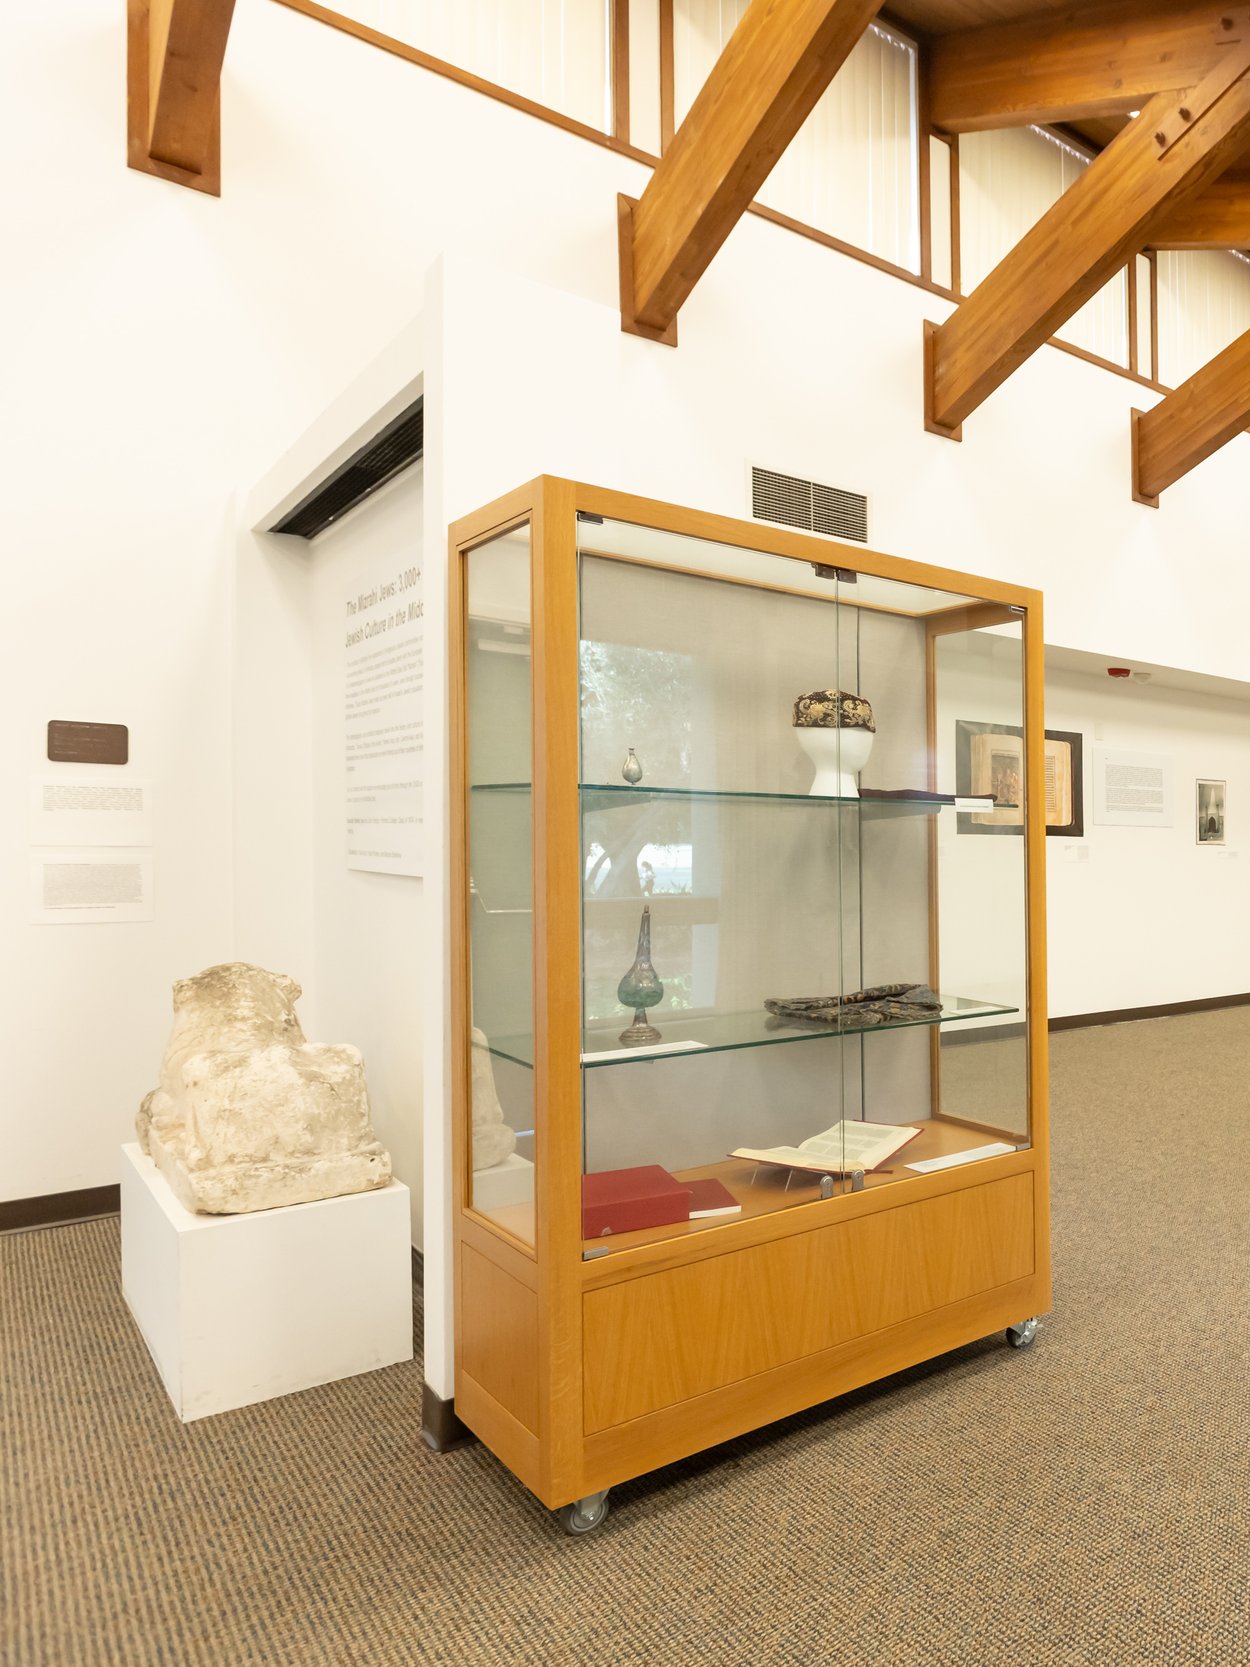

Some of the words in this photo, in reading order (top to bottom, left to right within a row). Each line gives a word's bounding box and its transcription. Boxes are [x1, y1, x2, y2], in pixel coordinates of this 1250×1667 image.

[346, 601, 357, 617] The
[358, 586, 377, 612] Mizrahi
[379, 582, 397, 602] Jews:
[399, 567, 421, 593] 3,000+
[345, 626, 363, 648] Jewish
[365, 619, 387, 639] Culture
[387, 613, 395, 630] in
[396, 609, 406, 626] the
